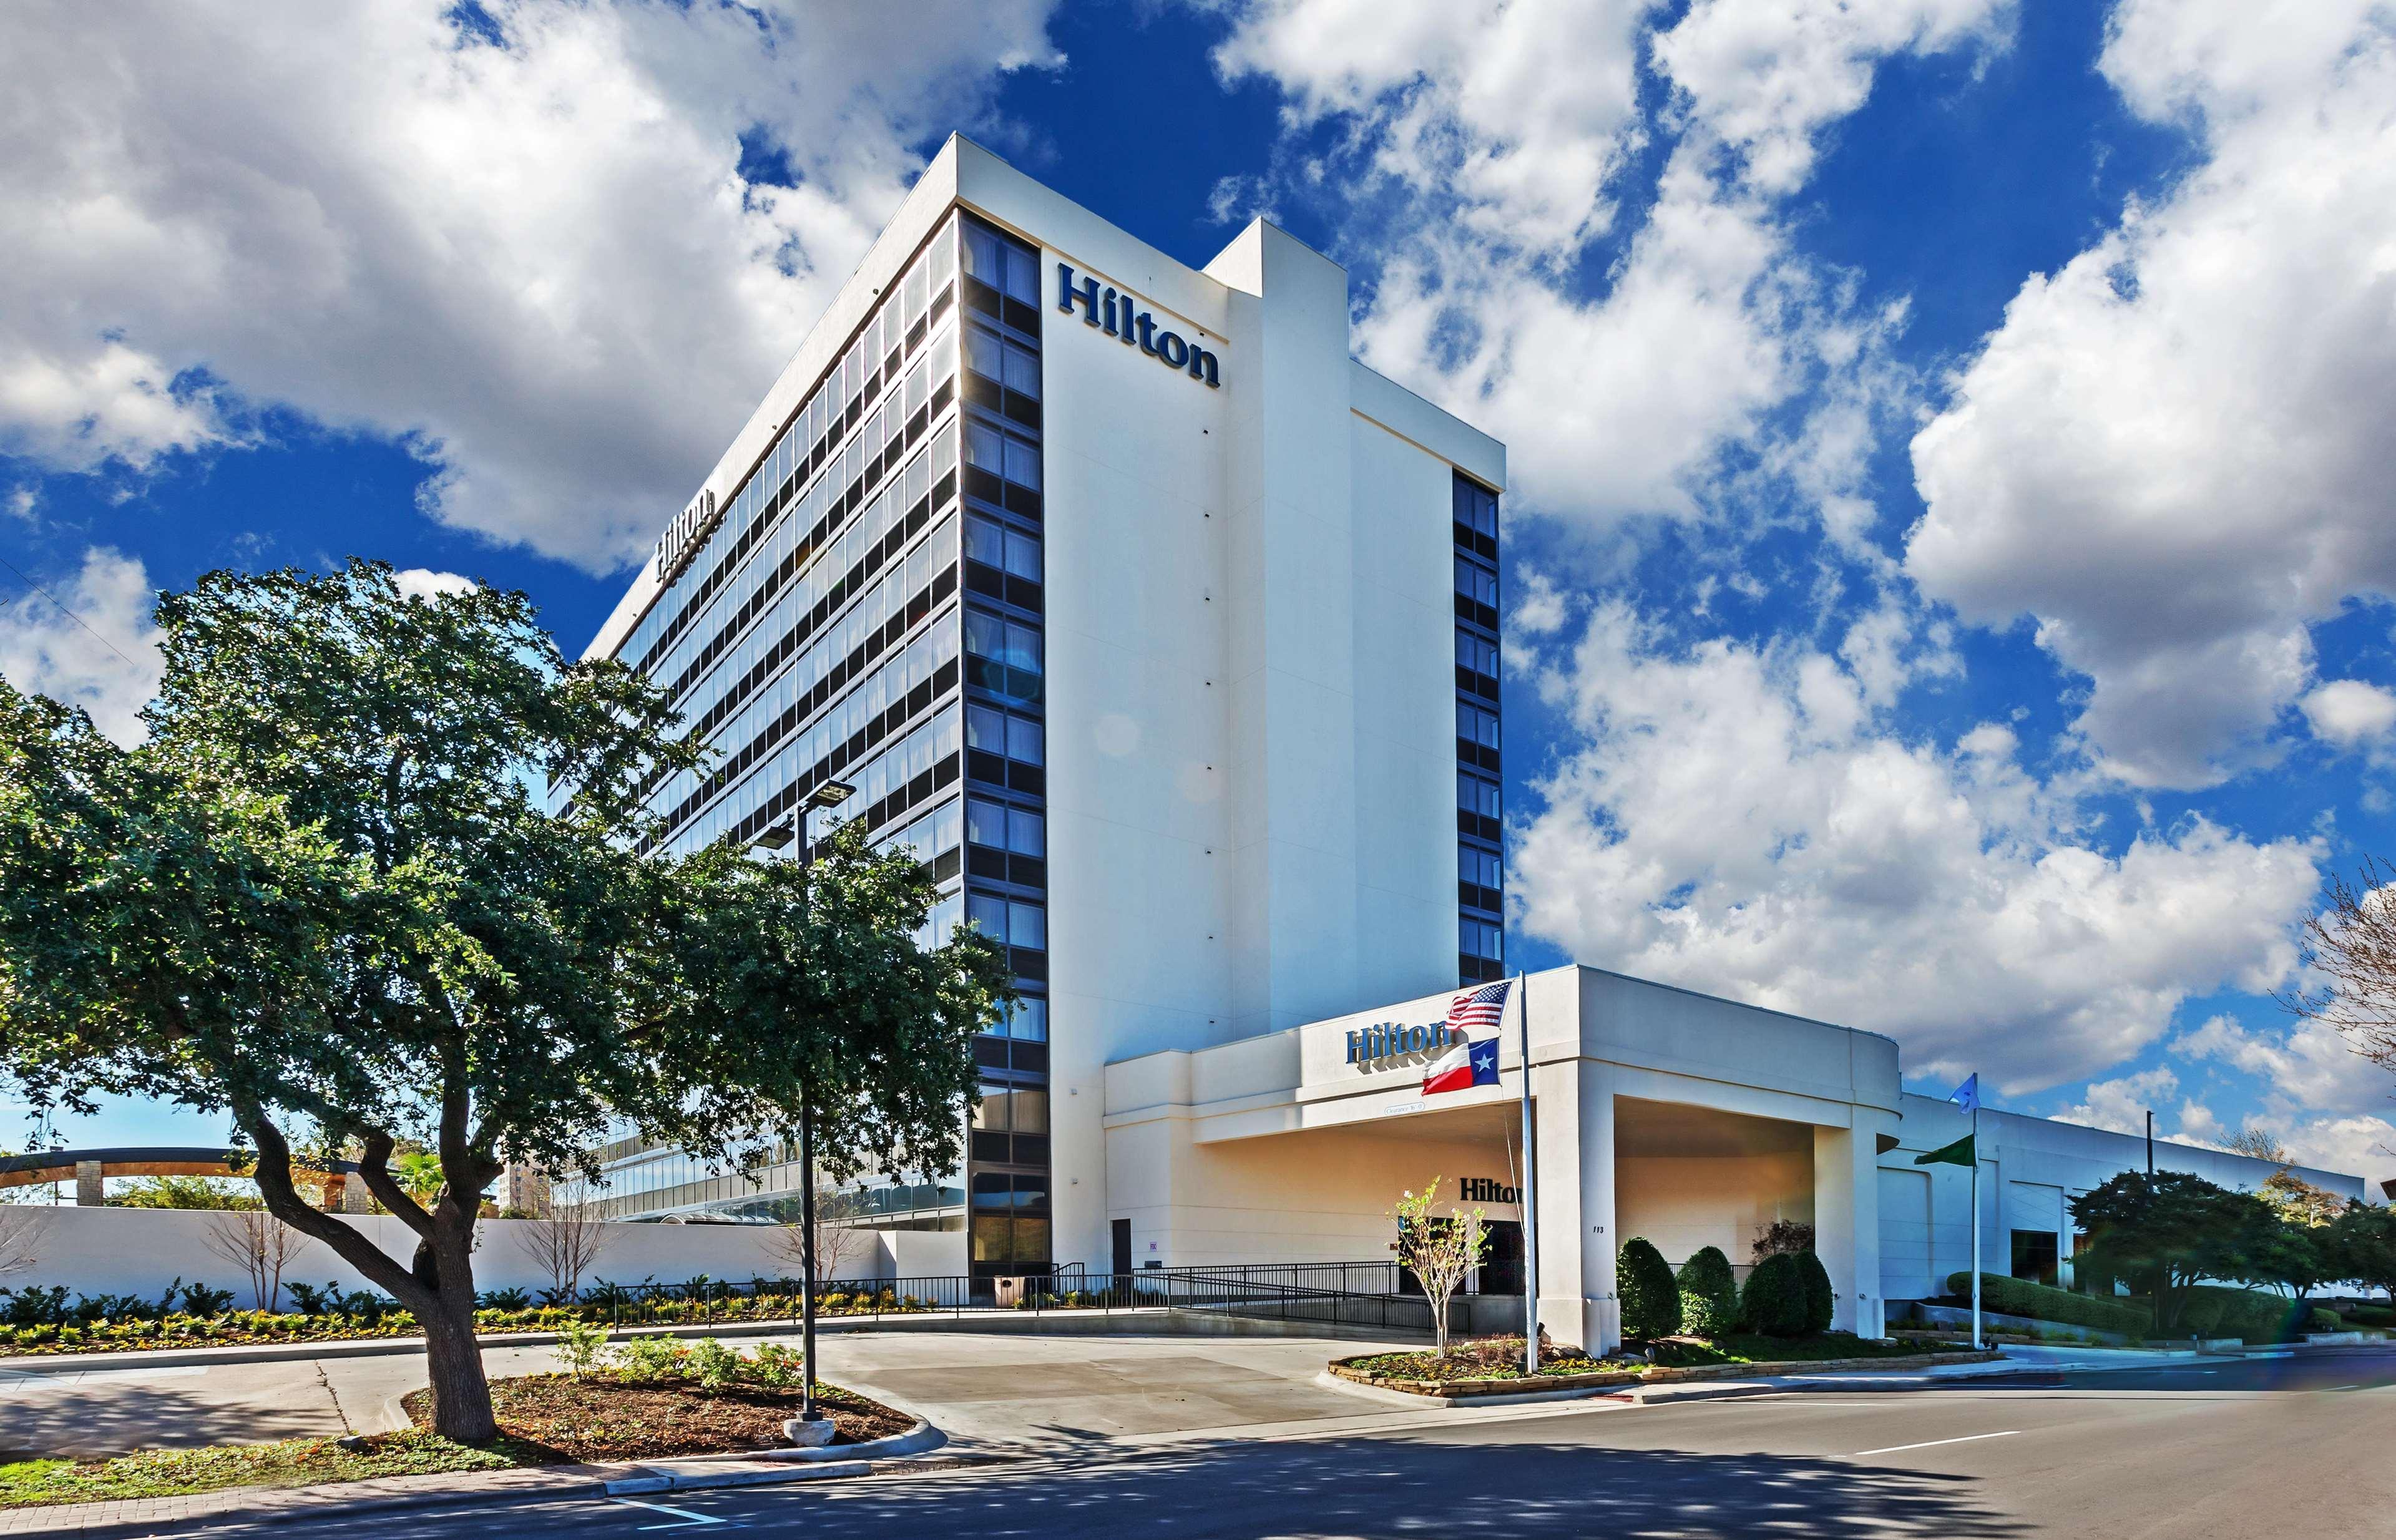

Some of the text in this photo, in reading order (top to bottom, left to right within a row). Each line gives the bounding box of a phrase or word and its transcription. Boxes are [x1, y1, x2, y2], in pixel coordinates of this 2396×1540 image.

[1058, 262, 1220, 389] Hilton
[655, 489, 716, 583] Hilton
[1346, 1020, 1453, 1065] Hilton
[1593, 1226, 1604, 1234] 113
